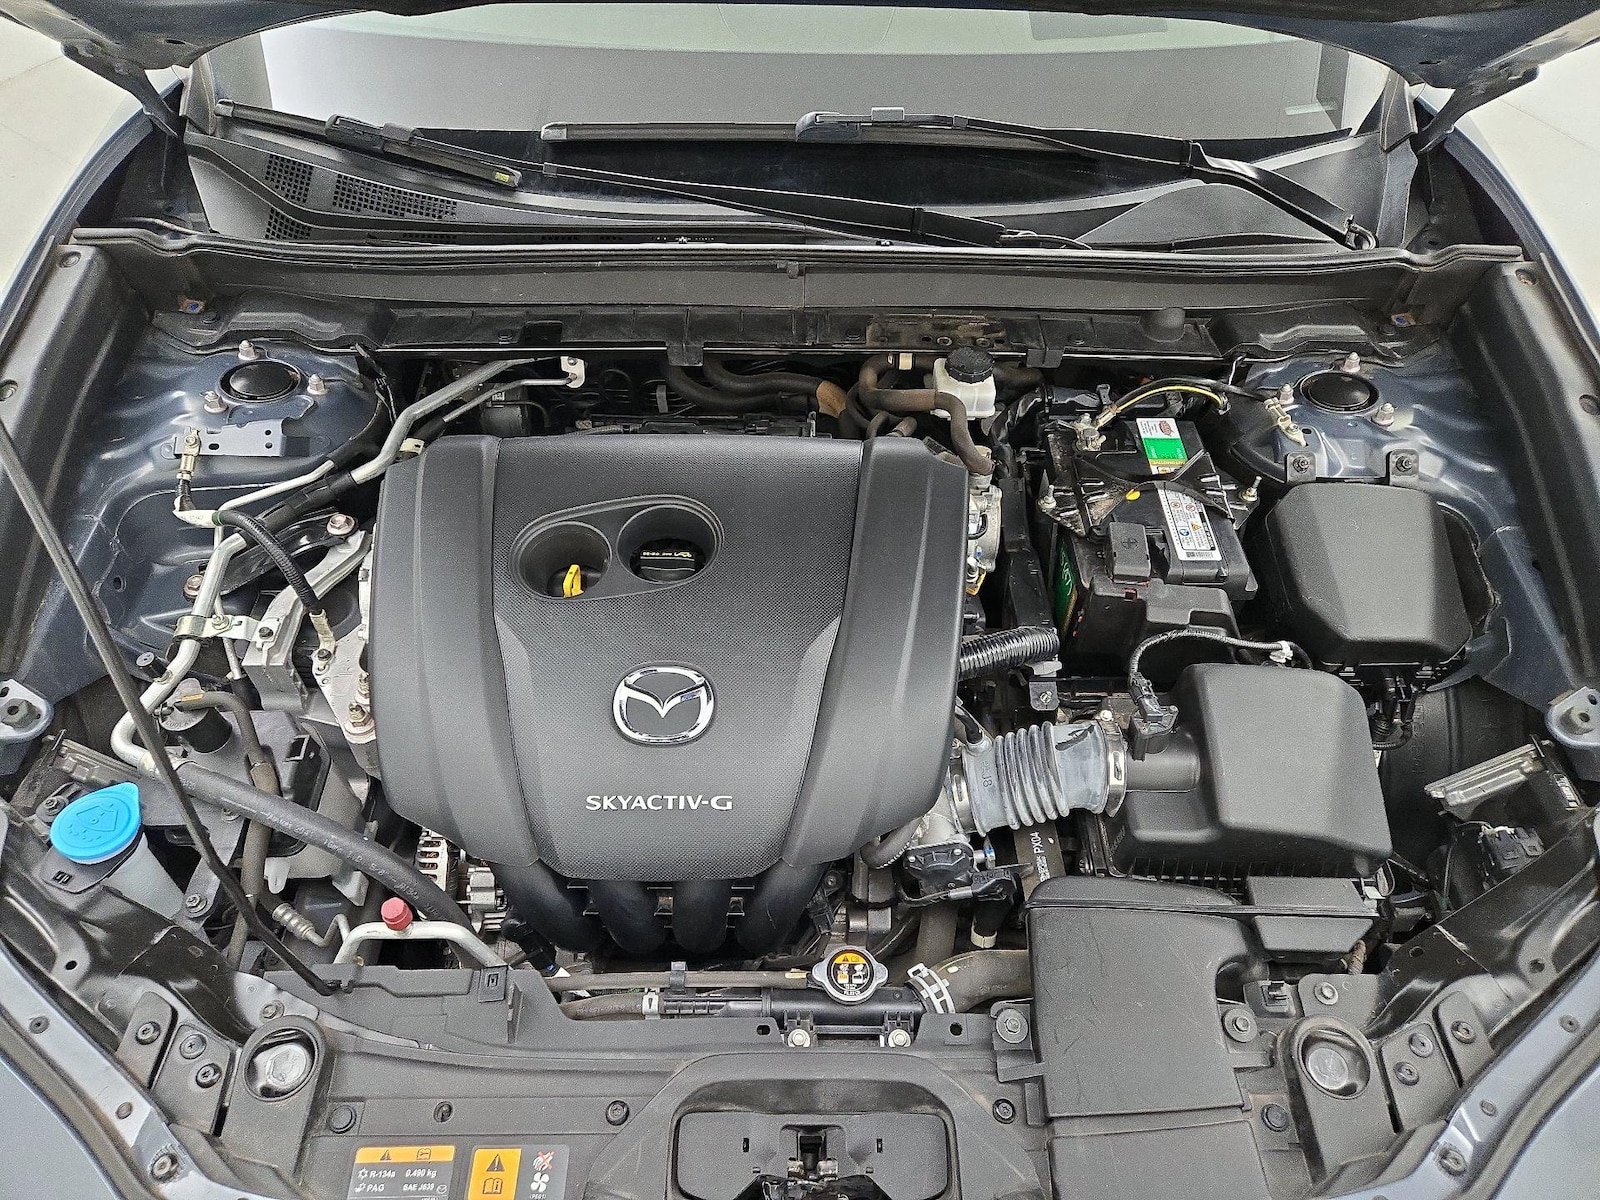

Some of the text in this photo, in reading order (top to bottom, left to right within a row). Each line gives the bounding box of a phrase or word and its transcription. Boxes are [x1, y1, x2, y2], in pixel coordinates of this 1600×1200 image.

[585, 794, 734, 811] SKYACTIV-G
[1029, 831, 1045, 855] PX04
[369, 1169, 396, 1179] R-134a
[405, 1168, 437, 1179] 0.490 kg
[366, 1183, 385, 1192] PAG
[402, 1183, 418, 1192] SAE
